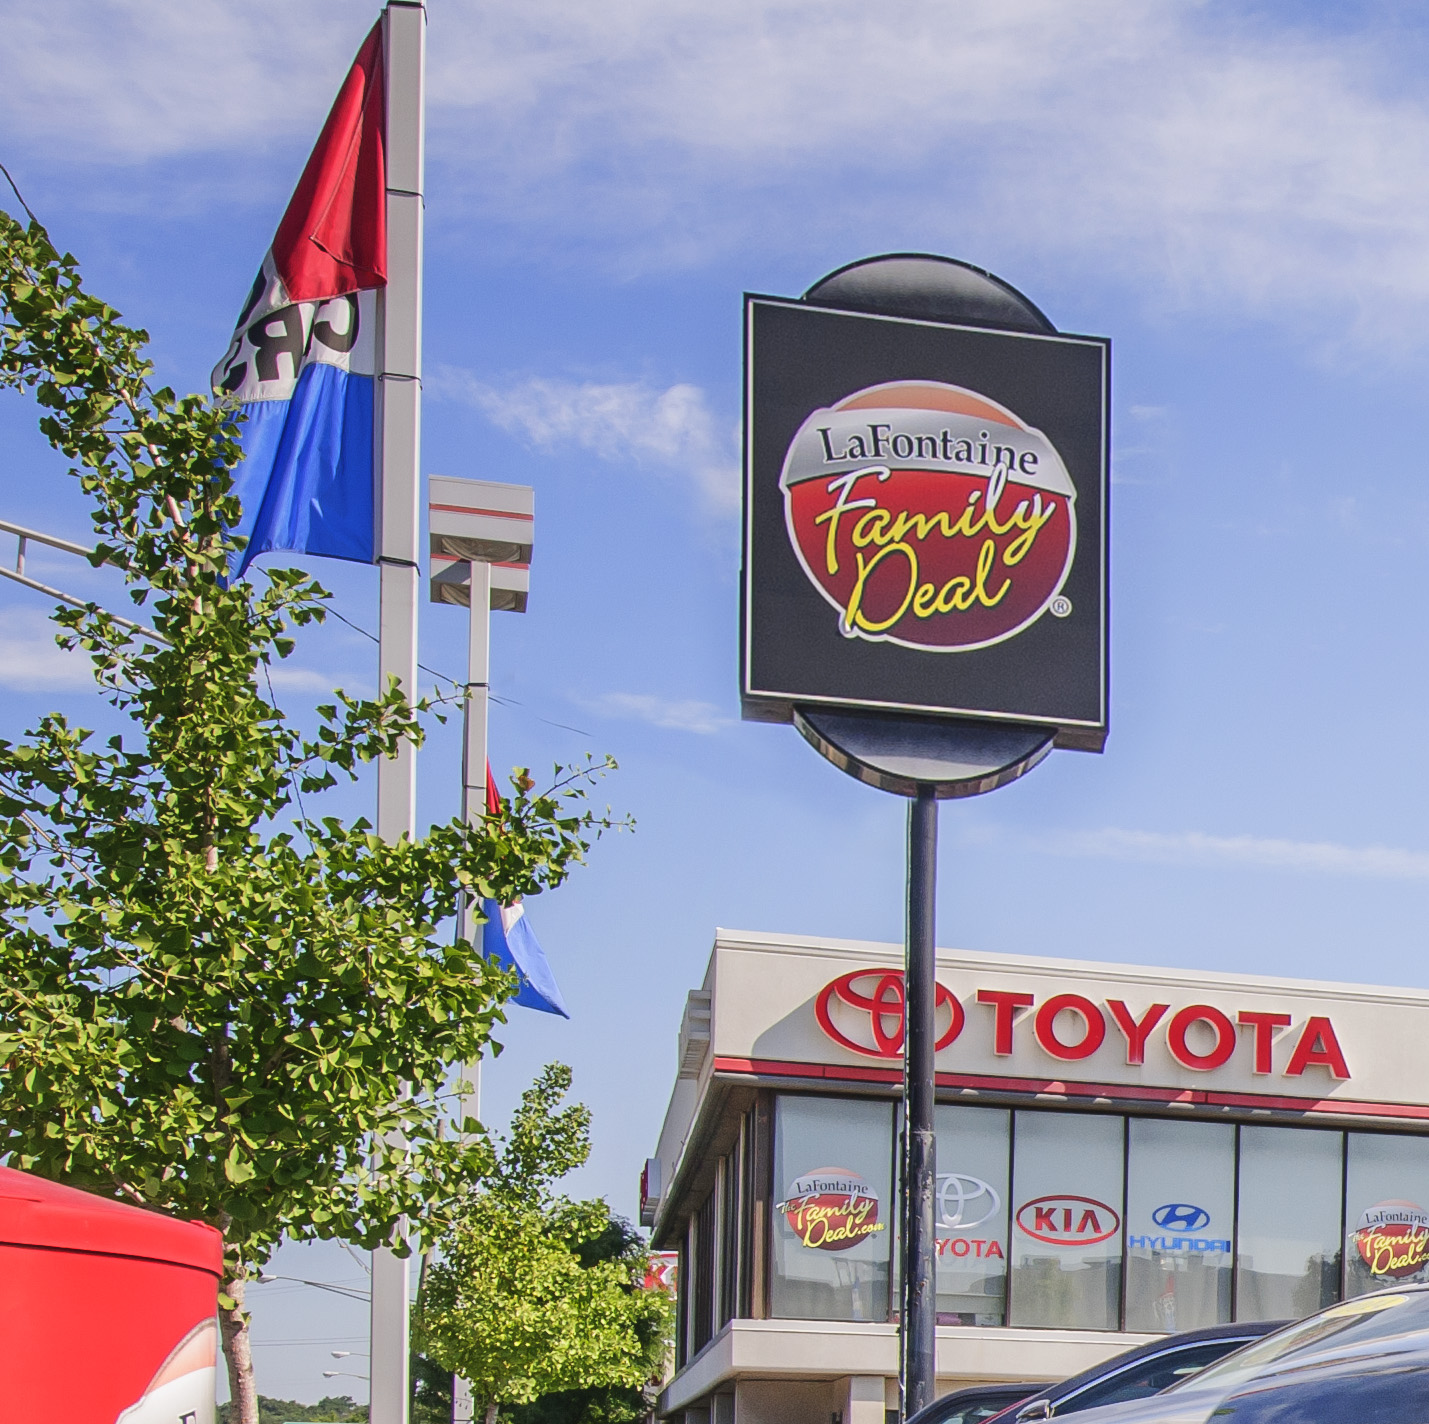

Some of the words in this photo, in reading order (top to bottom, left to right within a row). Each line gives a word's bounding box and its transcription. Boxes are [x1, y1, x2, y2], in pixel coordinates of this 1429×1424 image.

[816, 424, 1039, 475] LaFontaine
[815, 462, 1056, 575] Family
[845, 539, 1011, 632] Deal
[977, 988, 1352, 1080] TOYOTA
[796, 1180, 869, 1194] LaFontaine
[794, 1190, 874, 1230] Family
[1034, 1207, 1102, 1233] KIA
[1365, 1211, 1428, 1224] LaFontaine
[936, 1238, 1004, 1259] YOTA
[1128, 1235, 1231, 1253] HYUNDAI
